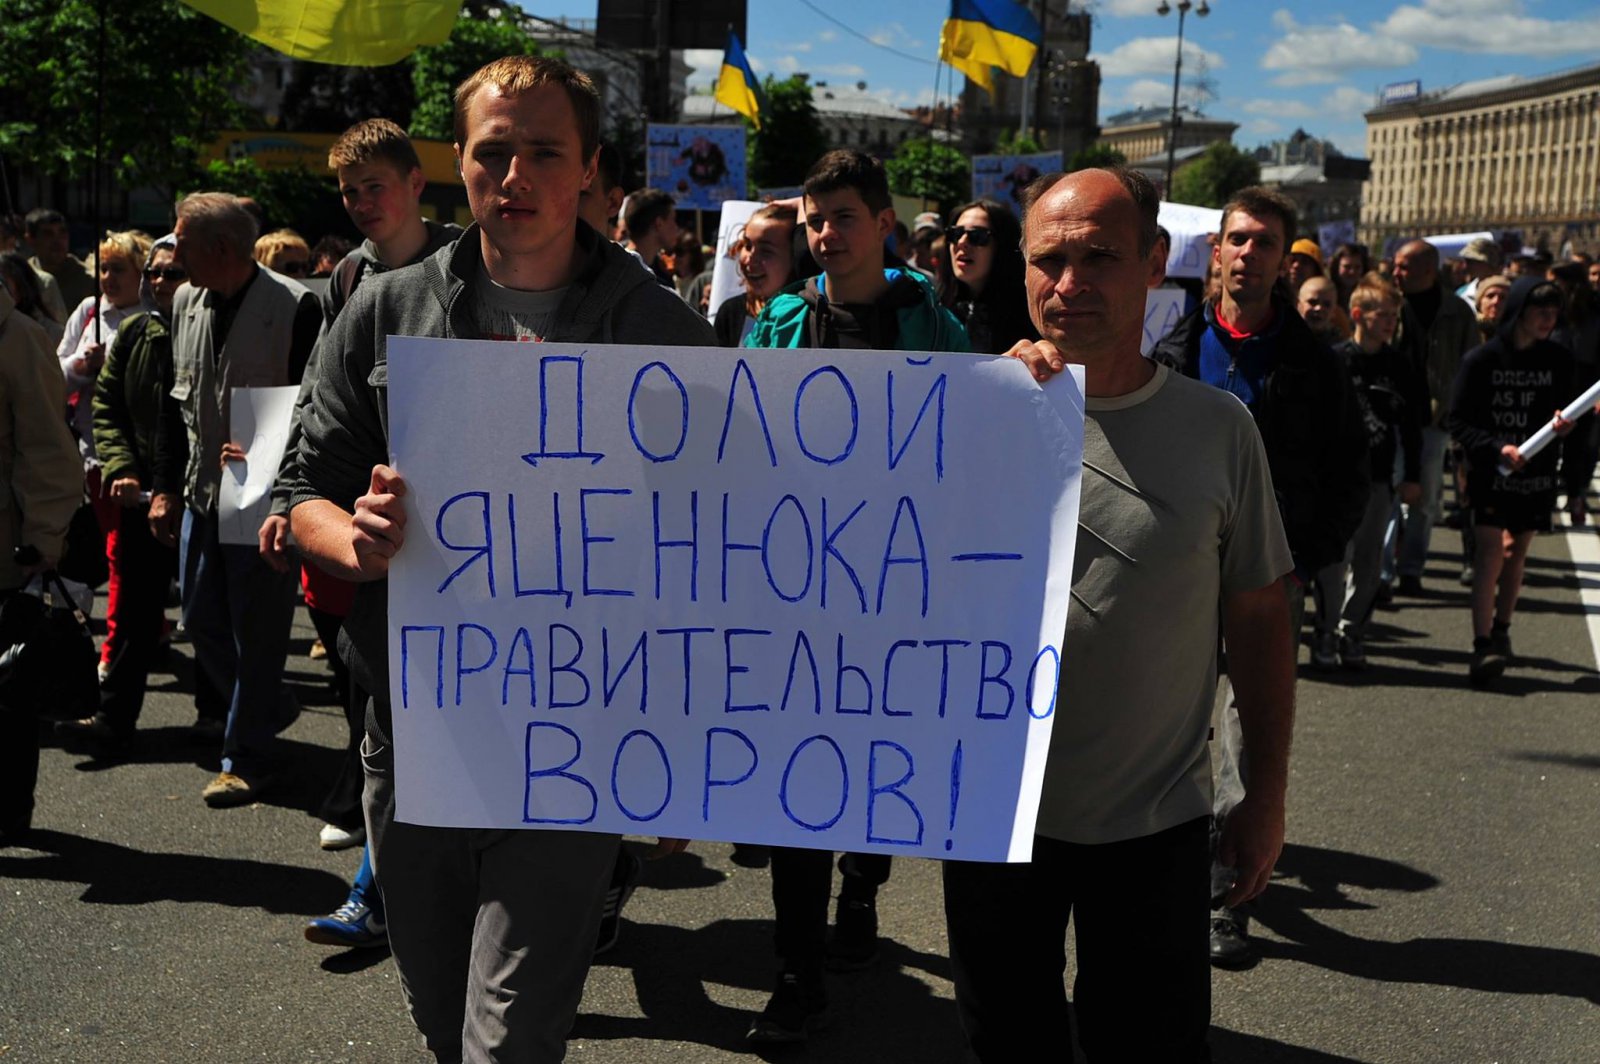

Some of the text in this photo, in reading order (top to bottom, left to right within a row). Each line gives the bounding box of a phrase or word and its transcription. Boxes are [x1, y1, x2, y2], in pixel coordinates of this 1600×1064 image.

[521, 350, 949, 484] ДОЛОЙ
[1491, 369, 1553, 386] DREAM
[1491, 390, 1536, 407] AS IF
[1491, 410, 1528, 428] YOU
[436, 488, 929, 617] ЯЦЕНЮКА
[401, 623, 1061, 720] ПРАВИТЕЛЬСТВО
[522, 721, 964, 852] ВОРОВ!
